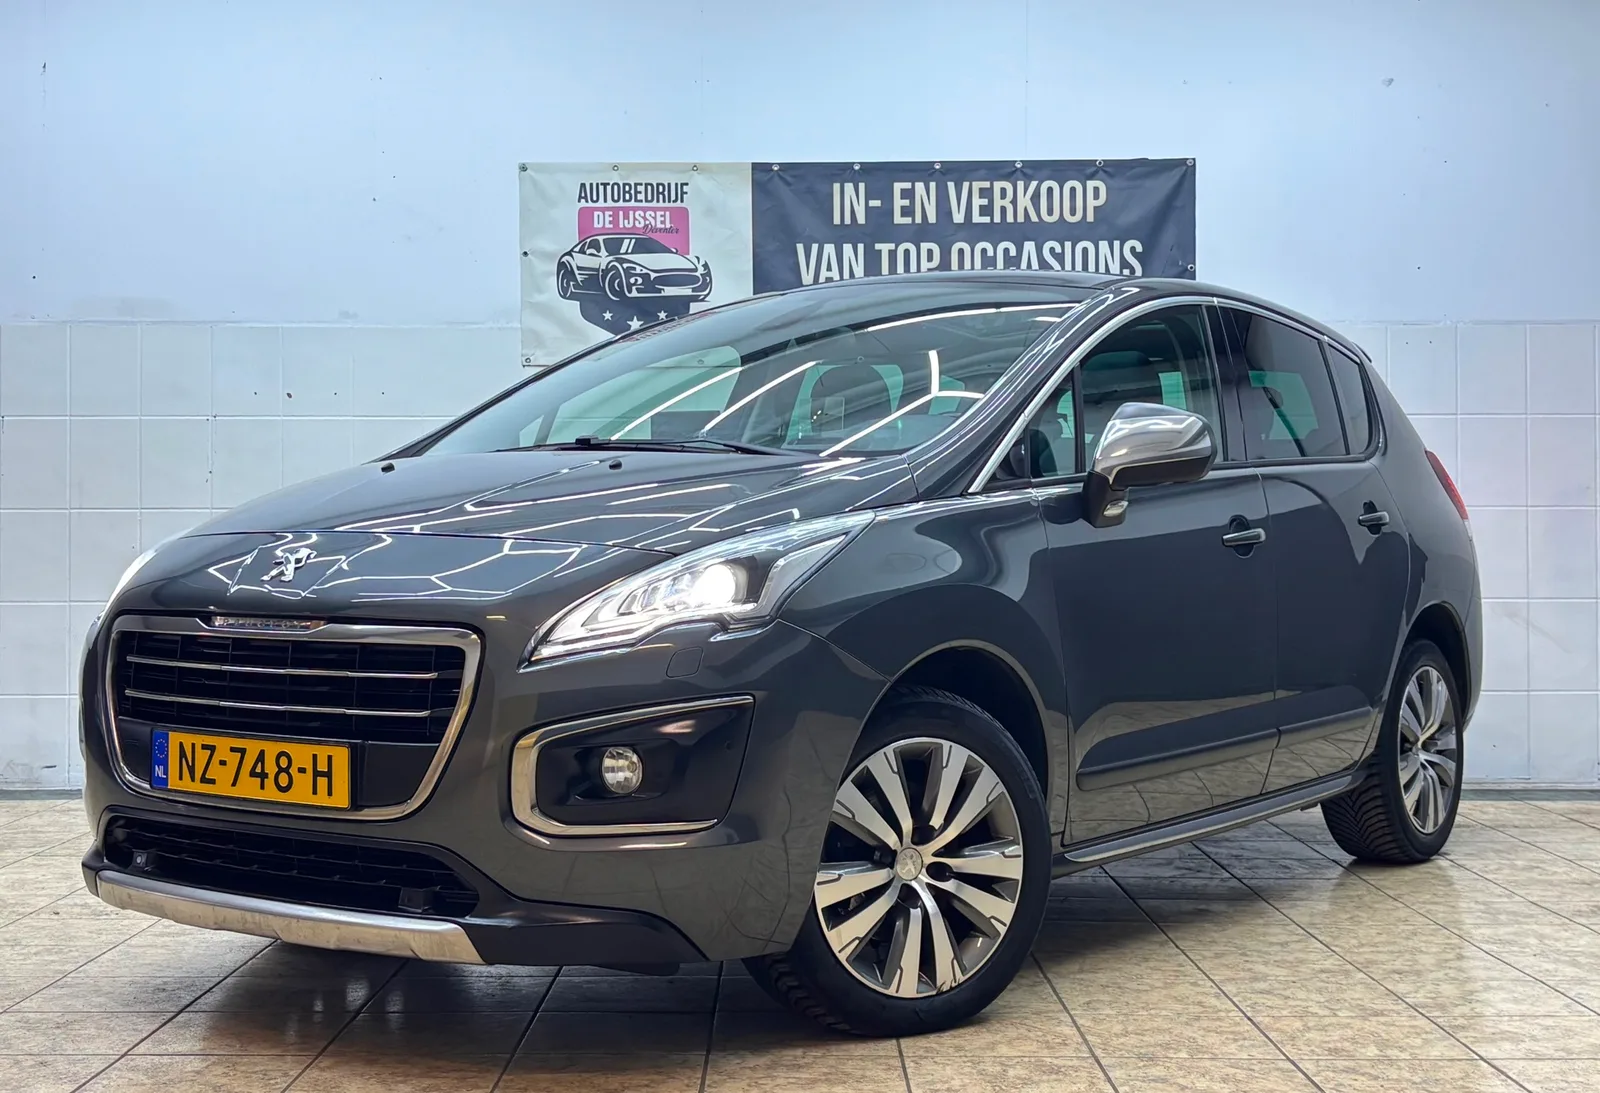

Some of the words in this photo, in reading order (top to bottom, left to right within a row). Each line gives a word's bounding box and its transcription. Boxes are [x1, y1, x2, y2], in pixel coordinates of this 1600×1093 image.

[577, 182, 689, 204] AUTOBEDRIJF
[832, 182, 882, 225] IN-
[893, 181, 937, 225] EN
[947, 180, 1107, 224] VERKOOP
[593, 211, 613, 228] DE
[619, 210, 674, 229] IJSSEL
[642, 223, 680, 235] Deventer
[796, 243, 865, 286] VAN
[874, 242, 941, 276] TOP
[951, 239, 1143, 277] OCCASIONS
[154, 764, 167, 779] NL
[178, 740, 333, 797] NZ-748-H
